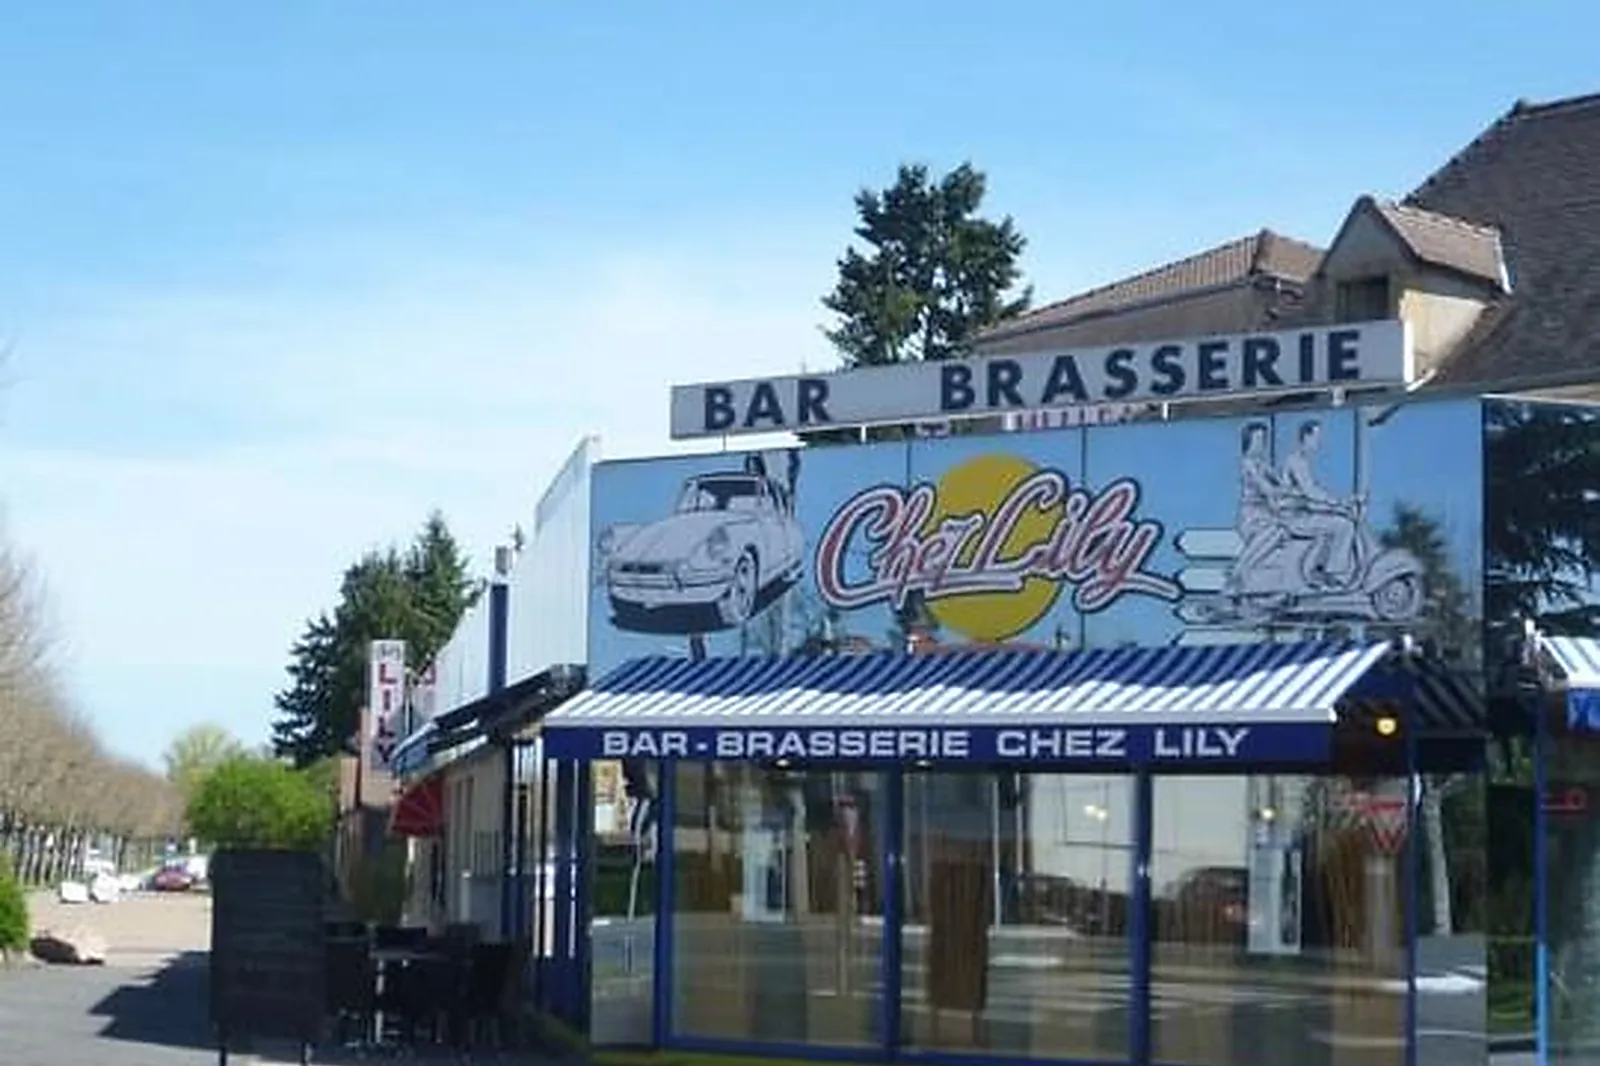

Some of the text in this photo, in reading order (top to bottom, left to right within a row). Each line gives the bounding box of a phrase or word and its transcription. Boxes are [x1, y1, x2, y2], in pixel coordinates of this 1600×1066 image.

[704, 330, 1360, 432] BAR BRASSERIE
[815, 468, 1182, 614] Chez Lily
[995, 729, 1126, 757] CHEZ
[1153, 727, 1250, 757] LILY
